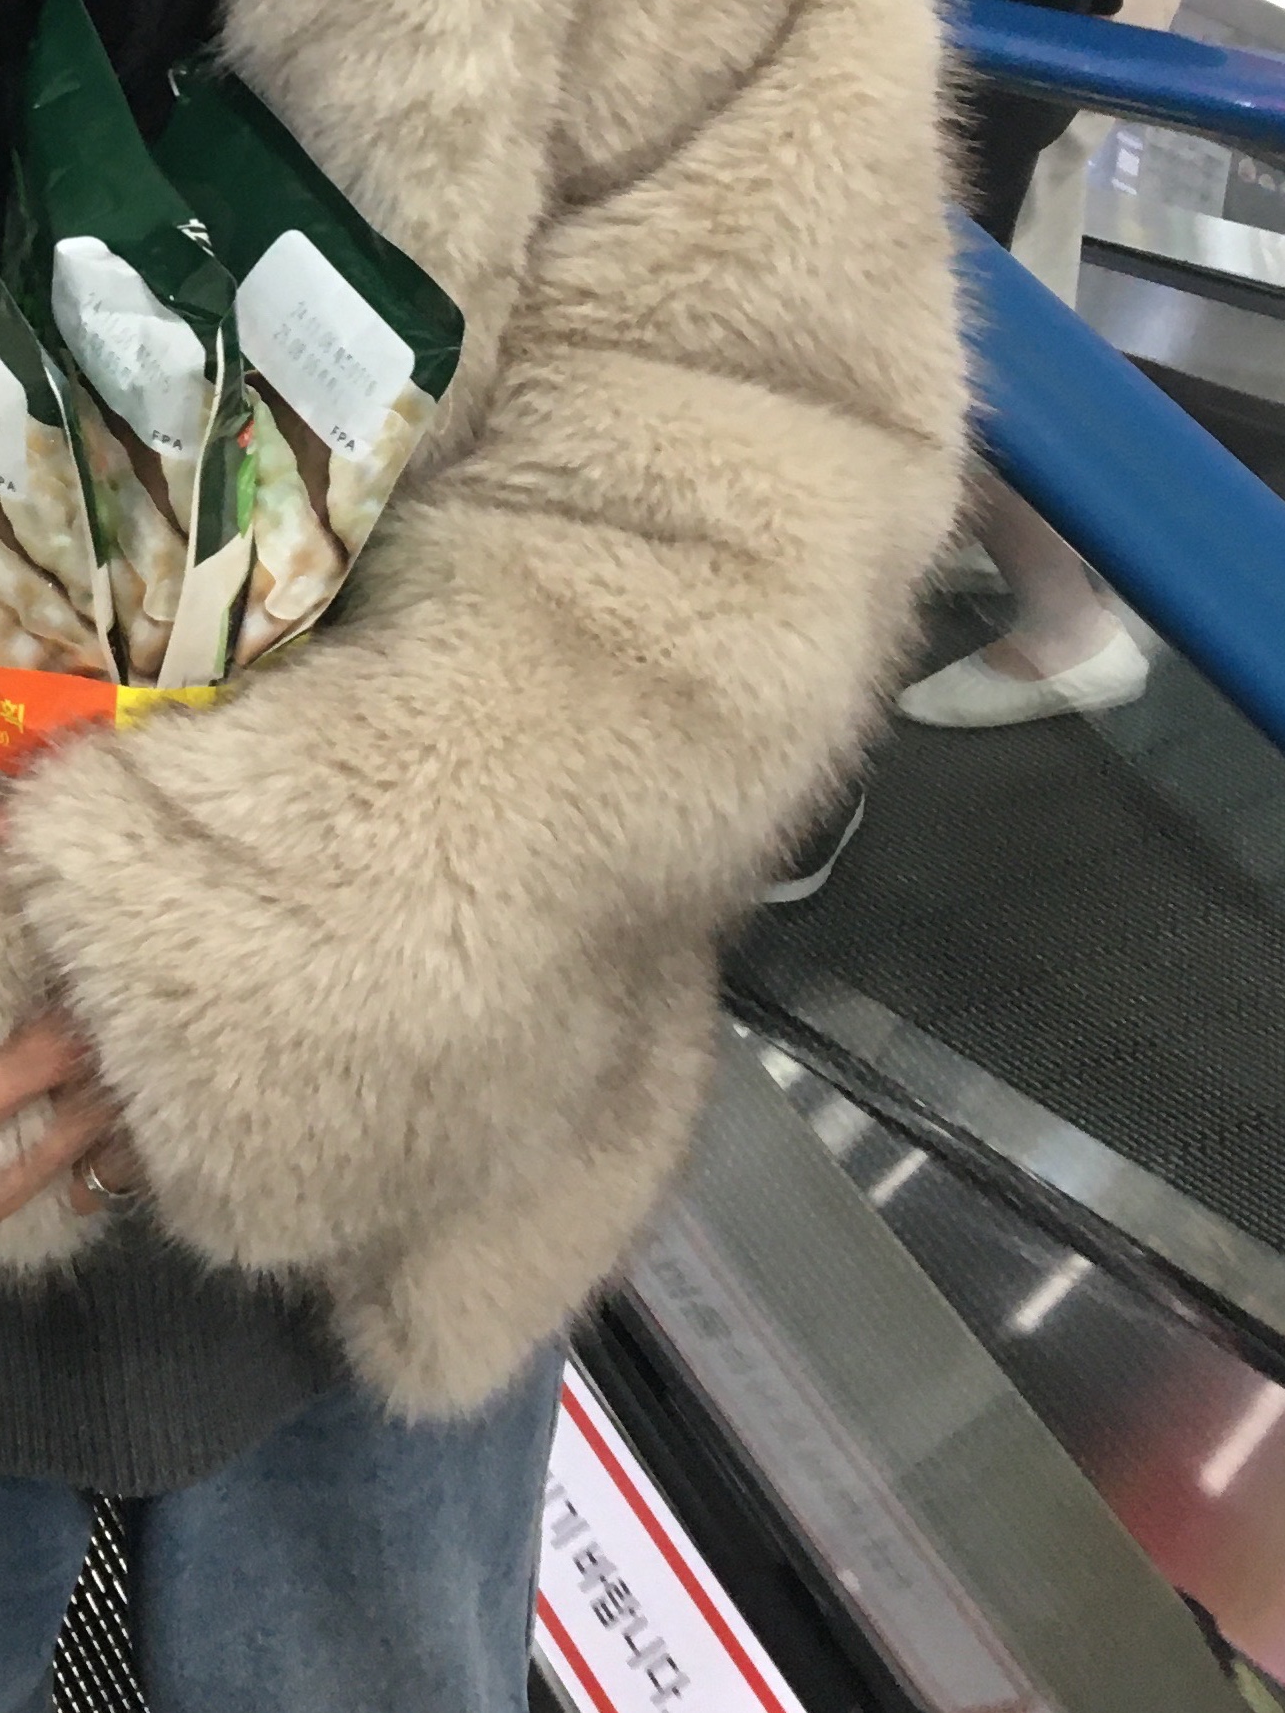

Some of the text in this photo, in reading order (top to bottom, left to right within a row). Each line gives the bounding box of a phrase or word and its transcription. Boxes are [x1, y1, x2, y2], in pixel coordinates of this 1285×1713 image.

[151, 429, 183, 451] FPA
[330, 424, 356, 452] FPA
[545, 1470, 590, 1550] 기
